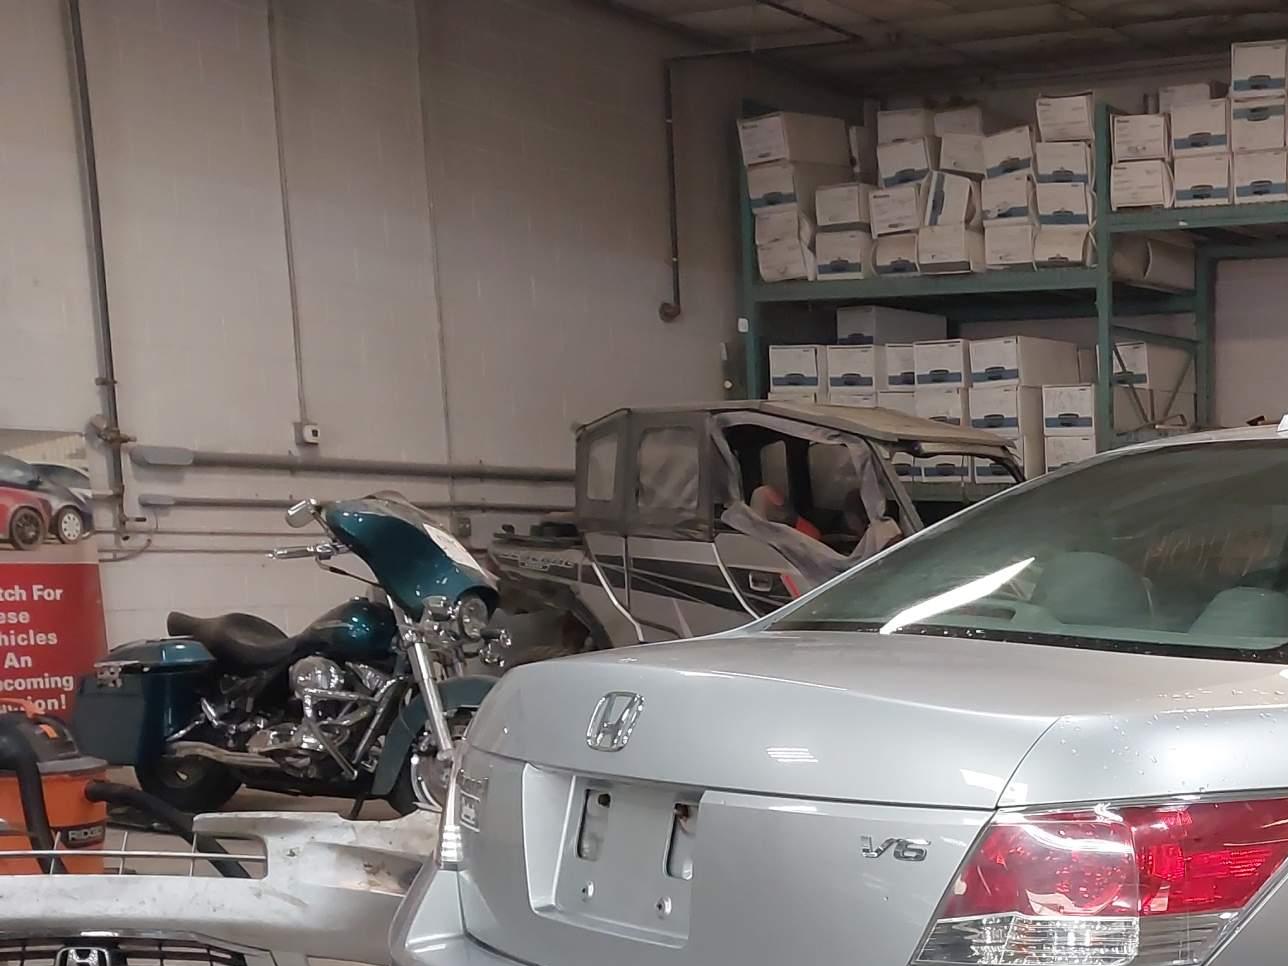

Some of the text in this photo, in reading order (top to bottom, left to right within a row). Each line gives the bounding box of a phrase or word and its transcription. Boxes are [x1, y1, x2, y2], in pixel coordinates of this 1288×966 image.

[32, 585, 64, 601] For
[4, 652, 33, 669] An
[860, 836, 931, 861] V6
